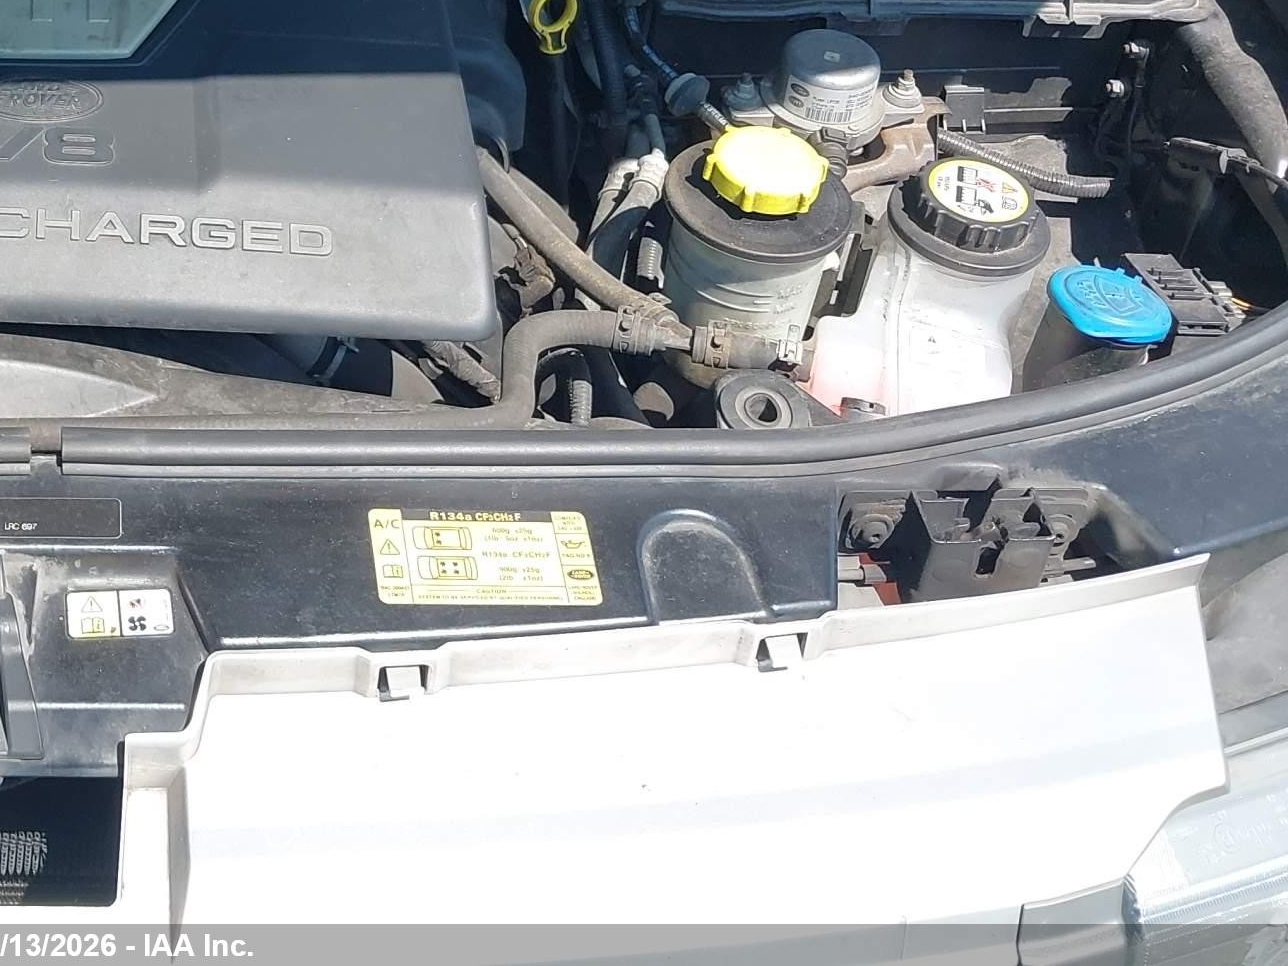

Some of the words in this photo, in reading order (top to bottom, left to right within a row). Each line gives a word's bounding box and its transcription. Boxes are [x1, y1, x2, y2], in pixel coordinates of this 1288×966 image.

[429, 511, 472, 521] R134a
[4, 522, 19, 530] LRC
[374, 519, 399, 529] A/C
